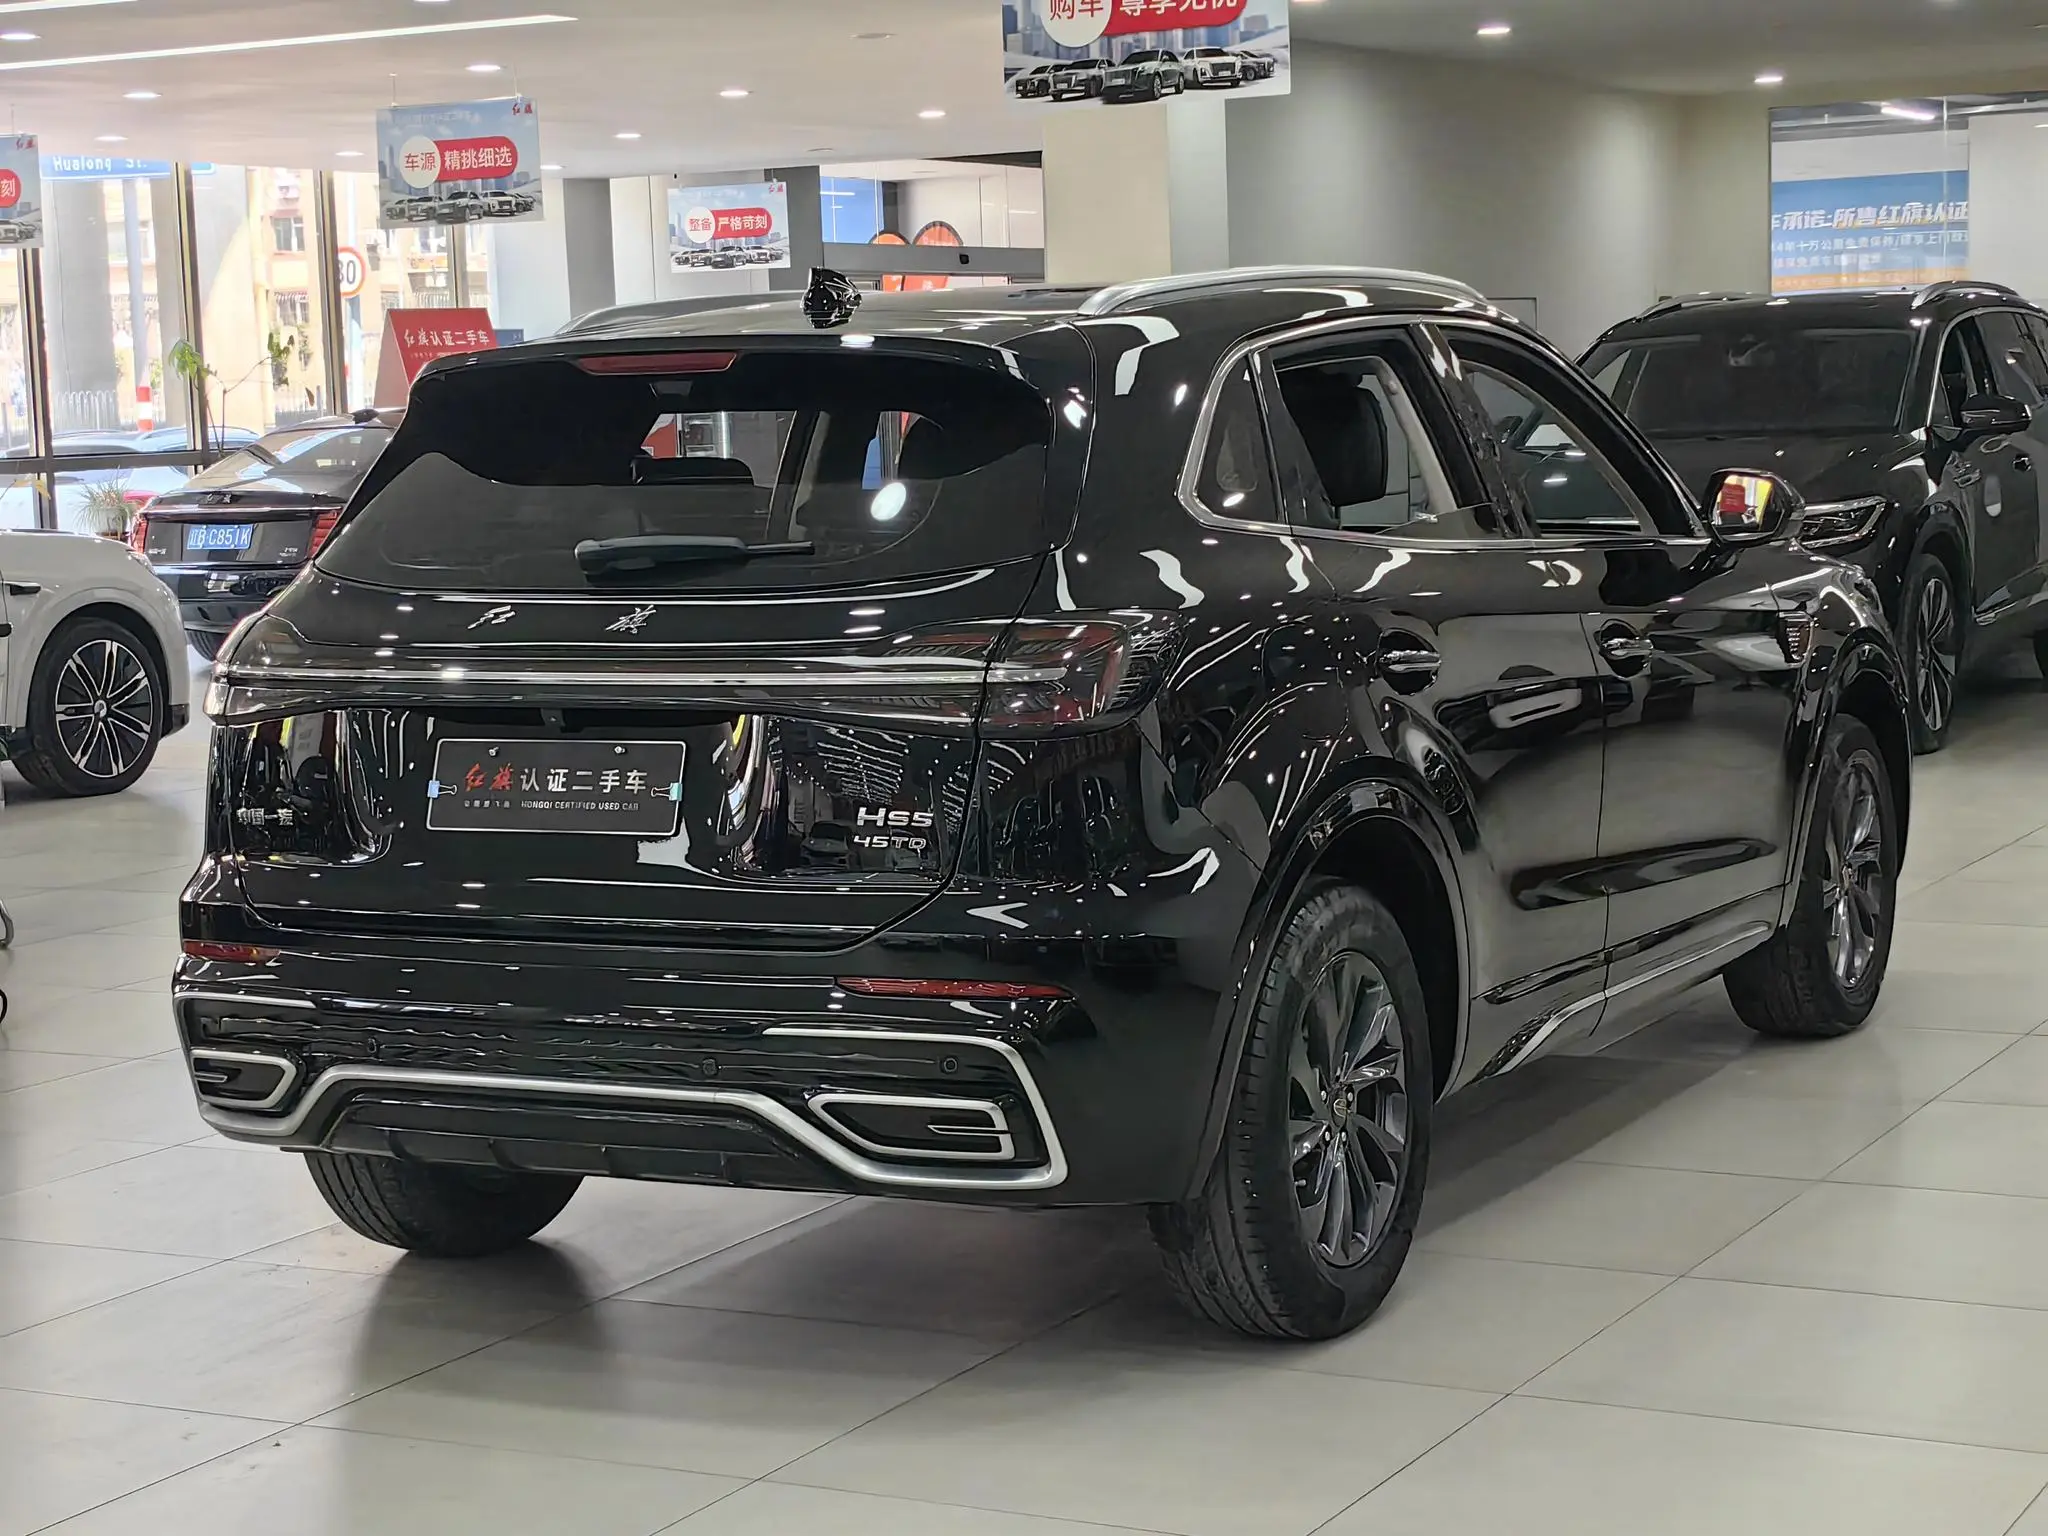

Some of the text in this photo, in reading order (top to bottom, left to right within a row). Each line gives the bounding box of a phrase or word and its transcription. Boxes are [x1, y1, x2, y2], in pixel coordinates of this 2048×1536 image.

[53, 155, 112, 172] Hualong
[404, 145, 513, 172] 车源 精挑细选
[521, 800, 553, 810] HONGQI
[554, 801, 596, 811] CERTIFIED
[598, 802, 620, 811] USED
[622, 802, 639, 811] CAR
[856, 806, 934, 828] HS5
